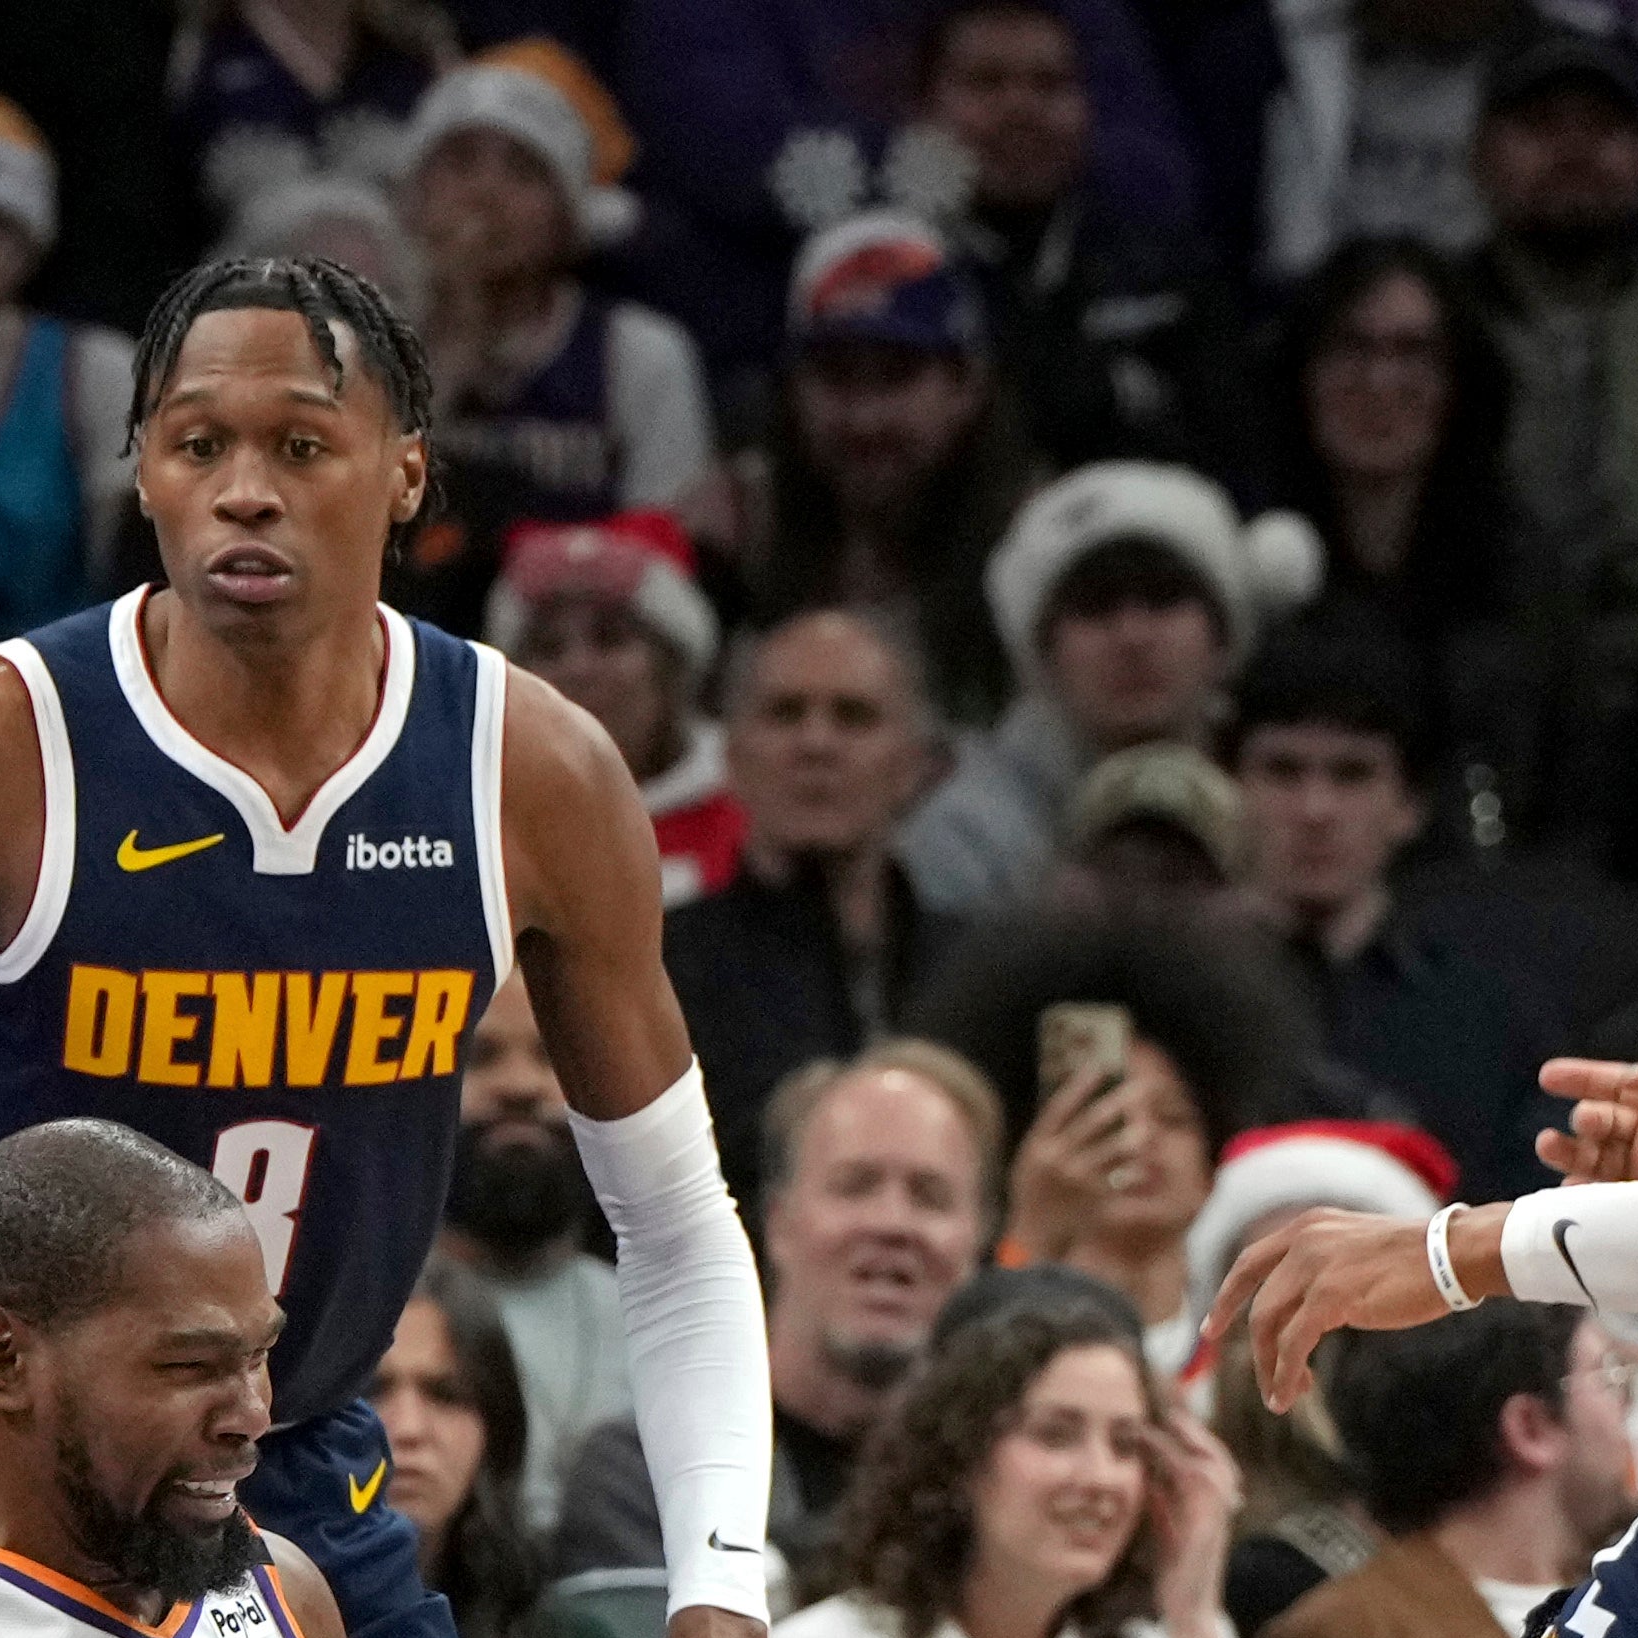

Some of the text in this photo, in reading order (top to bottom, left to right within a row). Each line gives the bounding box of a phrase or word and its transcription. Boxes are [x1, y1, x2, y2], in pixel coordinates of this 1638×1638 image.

[346, 833, 453, 870] ibotta
[62, 961, 475, 1090] DENVER
[211, 1116, 321, 1302] 8
